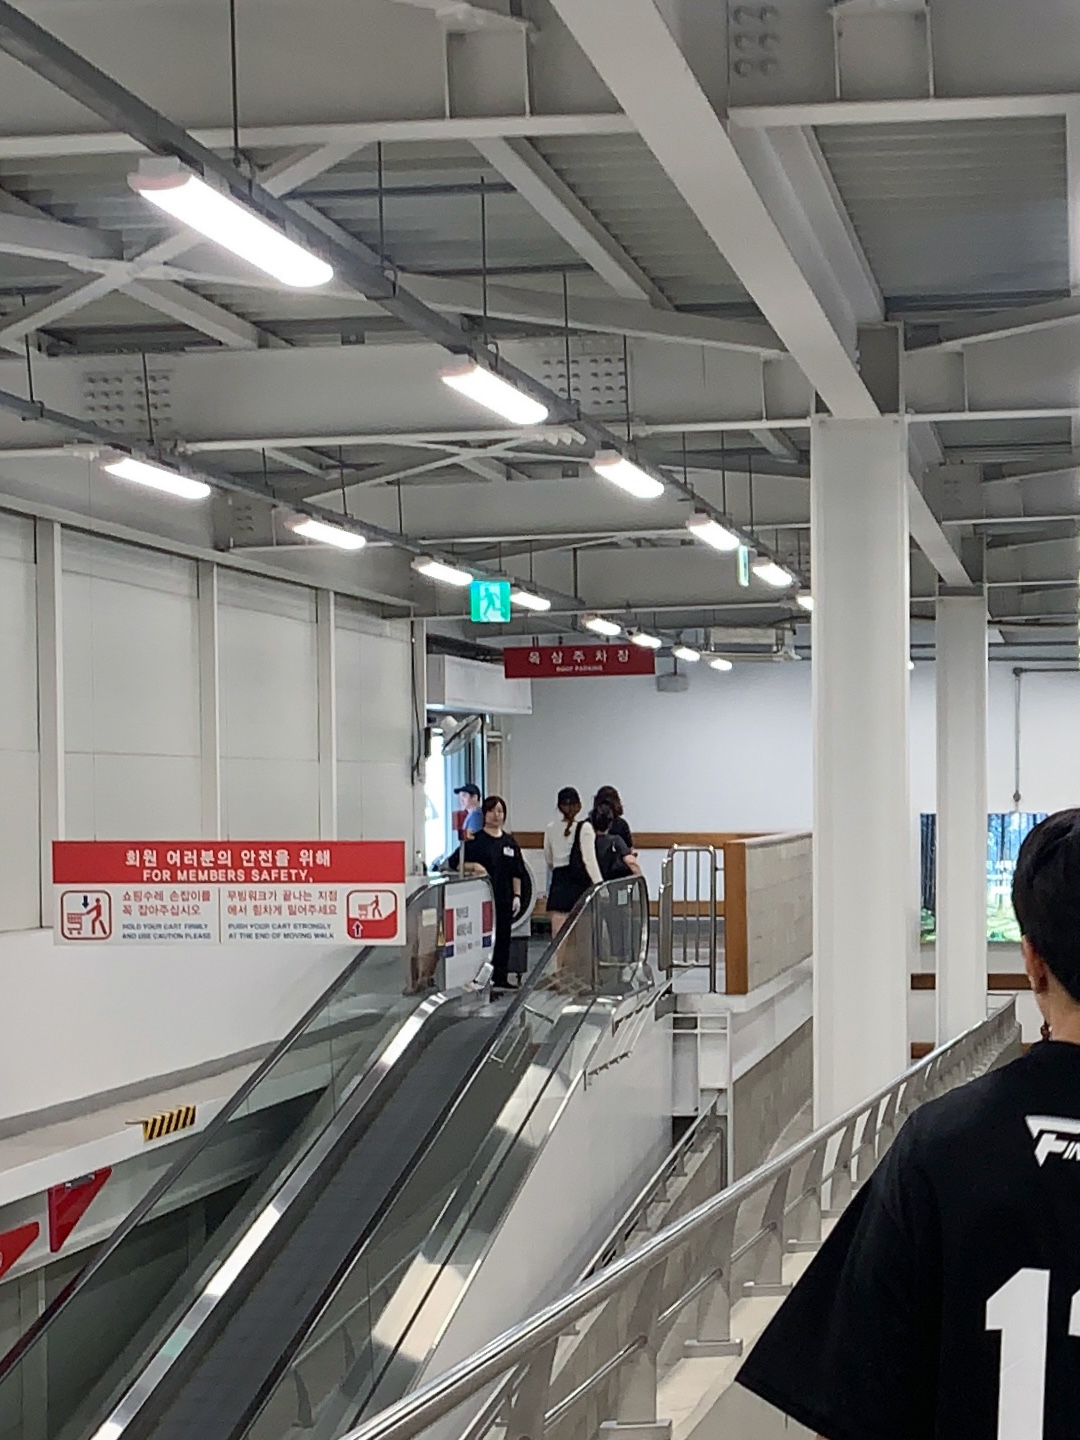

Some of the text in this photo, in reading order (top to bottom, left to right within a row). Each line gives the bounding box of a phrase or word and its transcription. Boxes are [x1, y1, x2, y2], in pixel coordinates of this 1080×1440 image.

[125, 849, 331, 867] 회원 여러분의 안전을 위해
[143, 869, 313, 883] FOR MEMBERS SAFETY,
[122, 890, 211, 902] 쇼핑수레 손잡이를
[228, 890, 277, 902] 무빙워크가
[283, 889, 312, 902] 끝나는
[138, 904, 201, 916] 잡아주십시오
[227, 904, 338, 916] 에서 힘차게 밀어주세요
